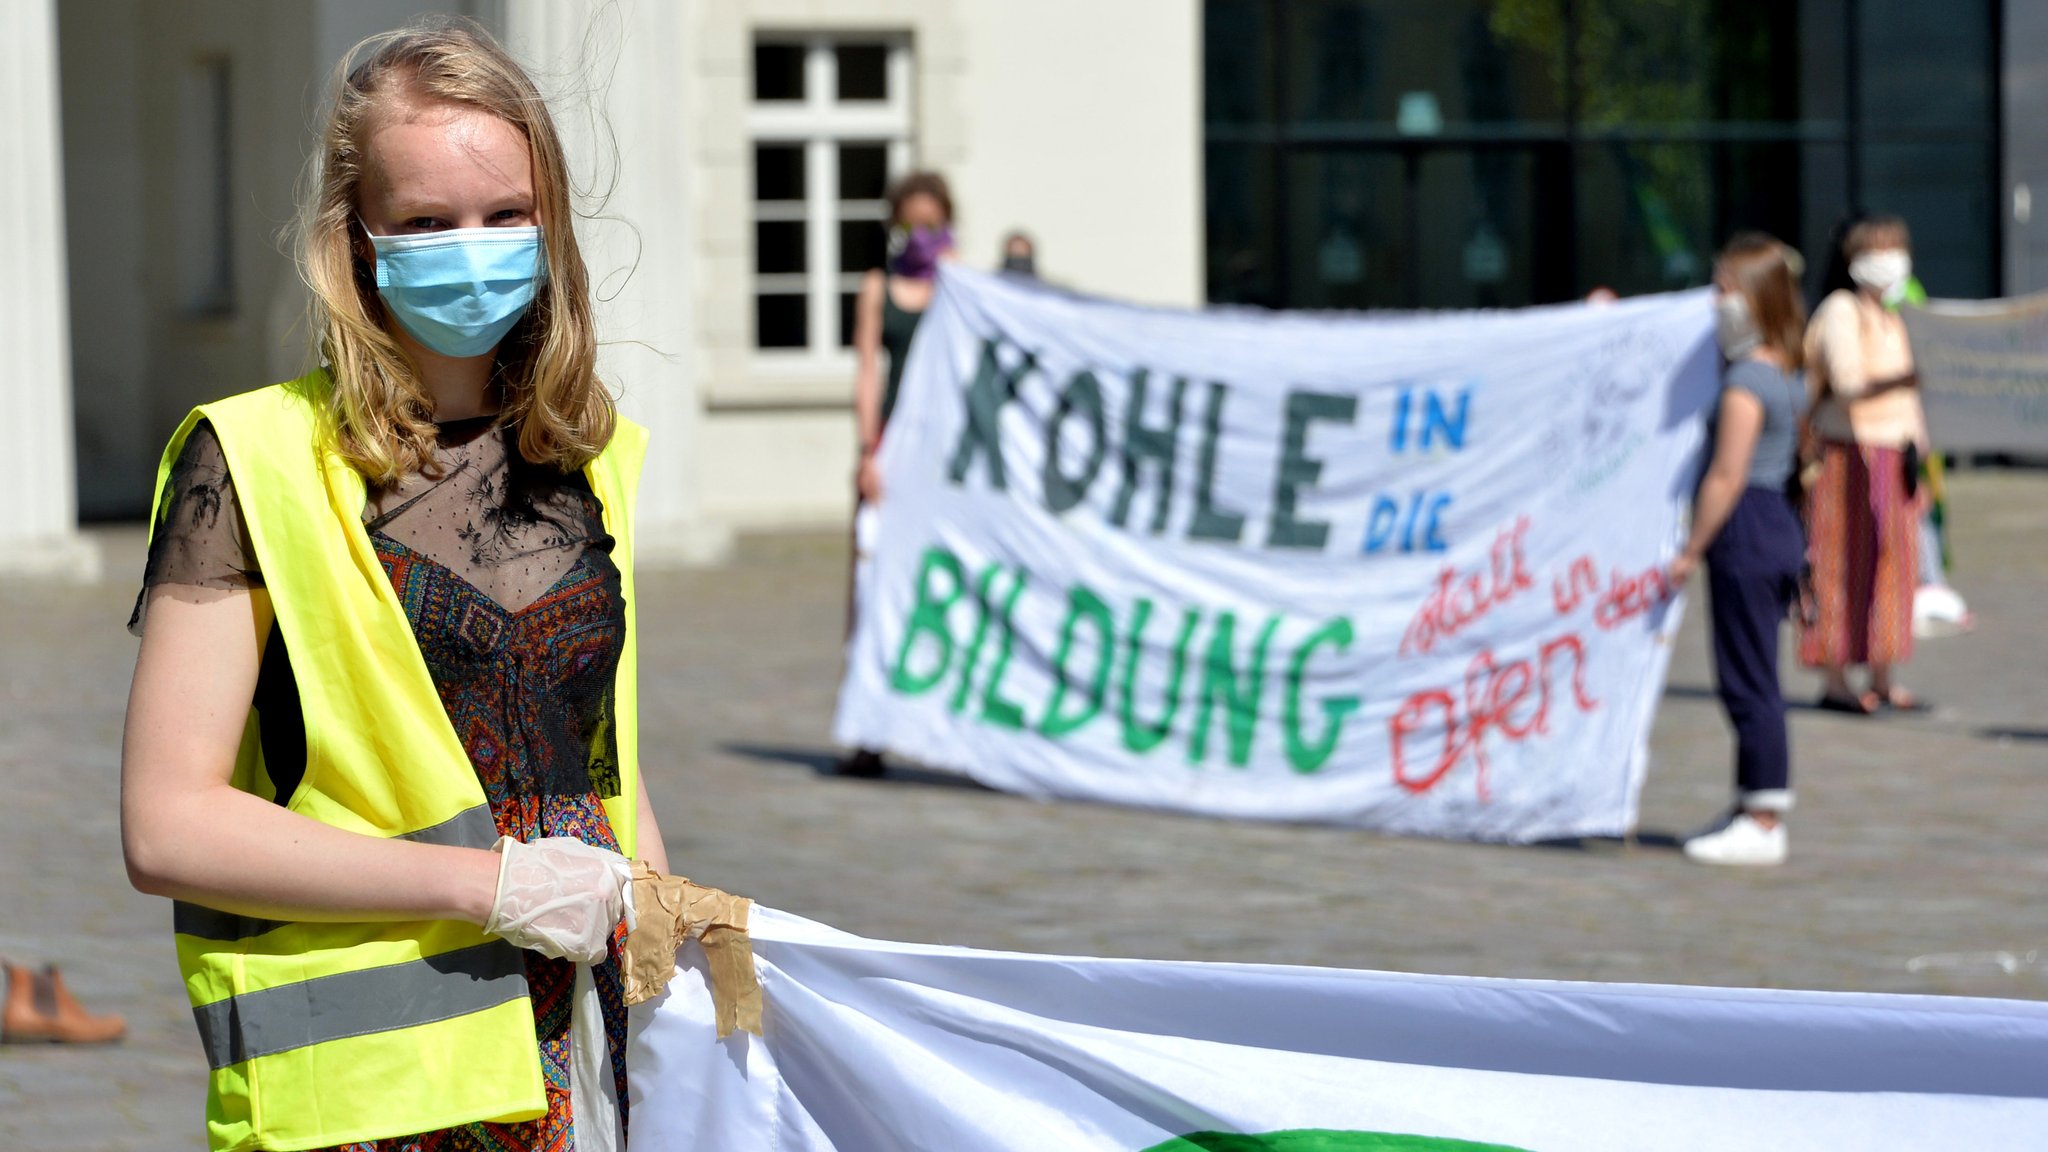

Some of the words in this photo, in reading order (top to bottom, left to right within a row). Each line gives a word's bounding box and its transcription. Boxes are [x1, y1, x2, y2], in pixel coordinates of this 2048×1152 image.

[948, 334, 1357, 549] KOHLE
[1391, 384, 1472, 453] IN
[1363, 490, 1453, 554] DIE
[1553, 553, 1598, 616] in
[888, 546, 1361, 773] BILDUNG
